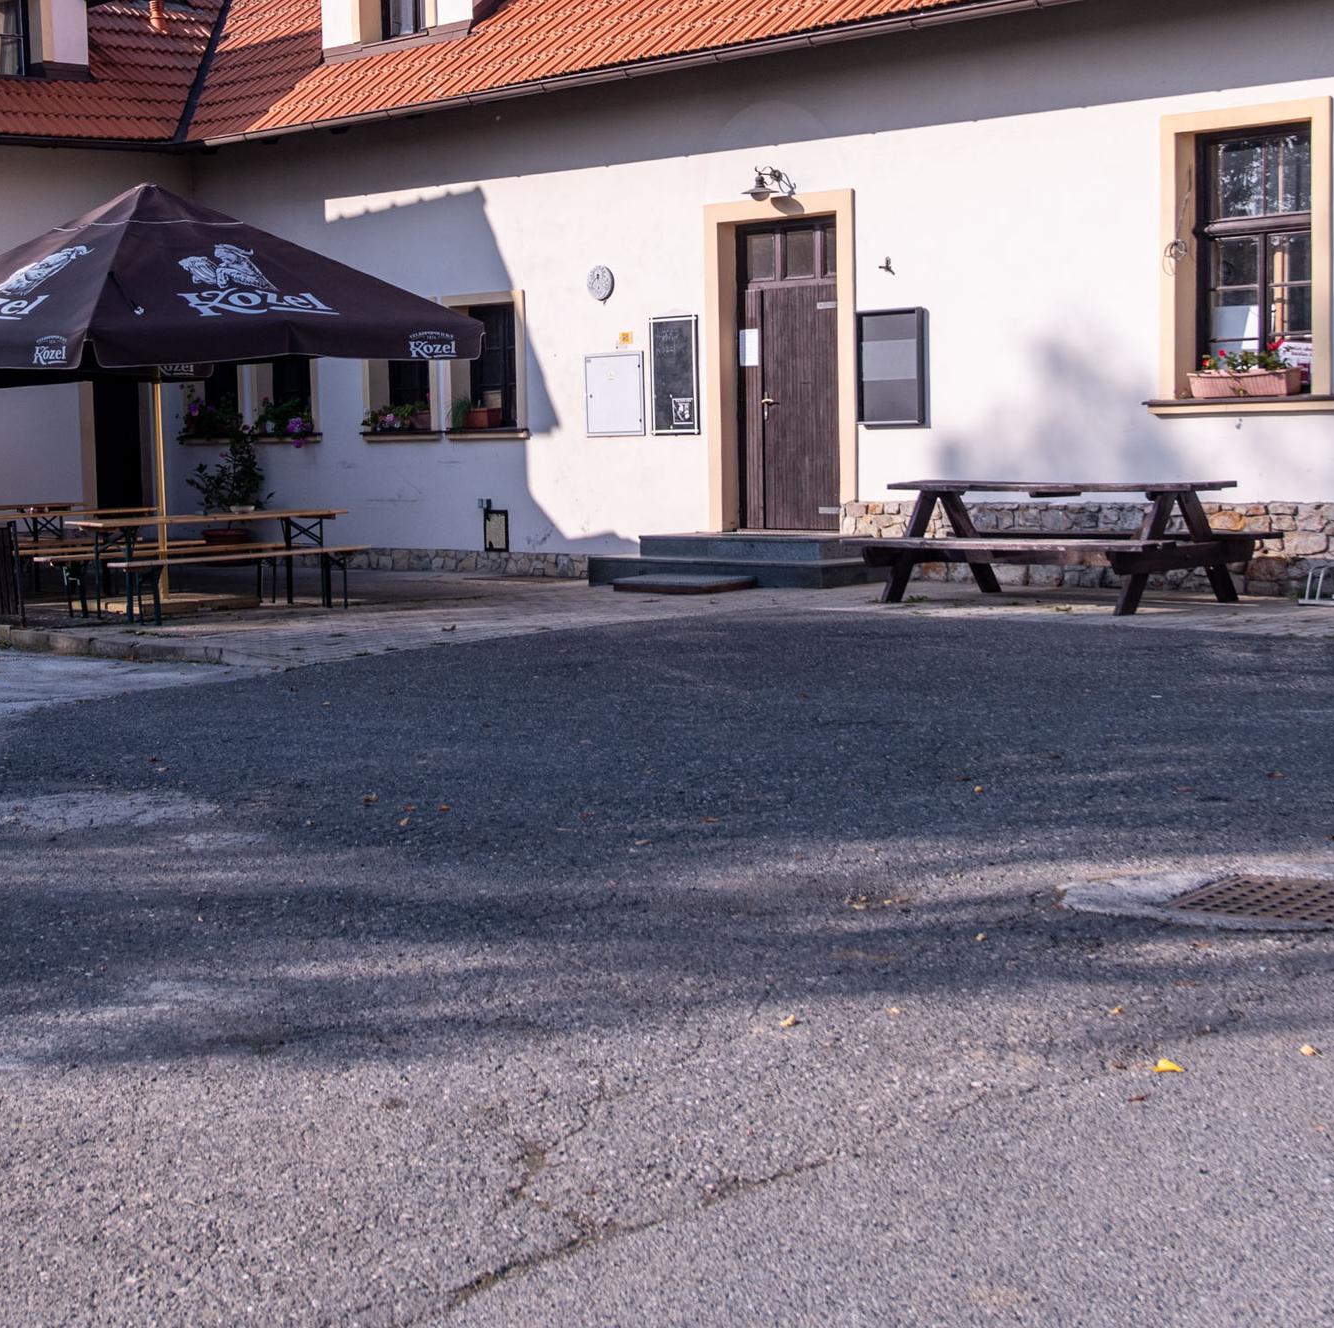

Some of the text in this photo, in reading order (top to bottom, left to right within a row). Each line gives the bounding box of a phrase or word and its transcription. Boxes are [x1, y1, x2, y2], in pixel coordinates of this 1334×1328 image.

[176, 287, 334, 317] Kozel
[32, 345, 67, 365] Kozel
[408, 341, 457, 359] Kozel
